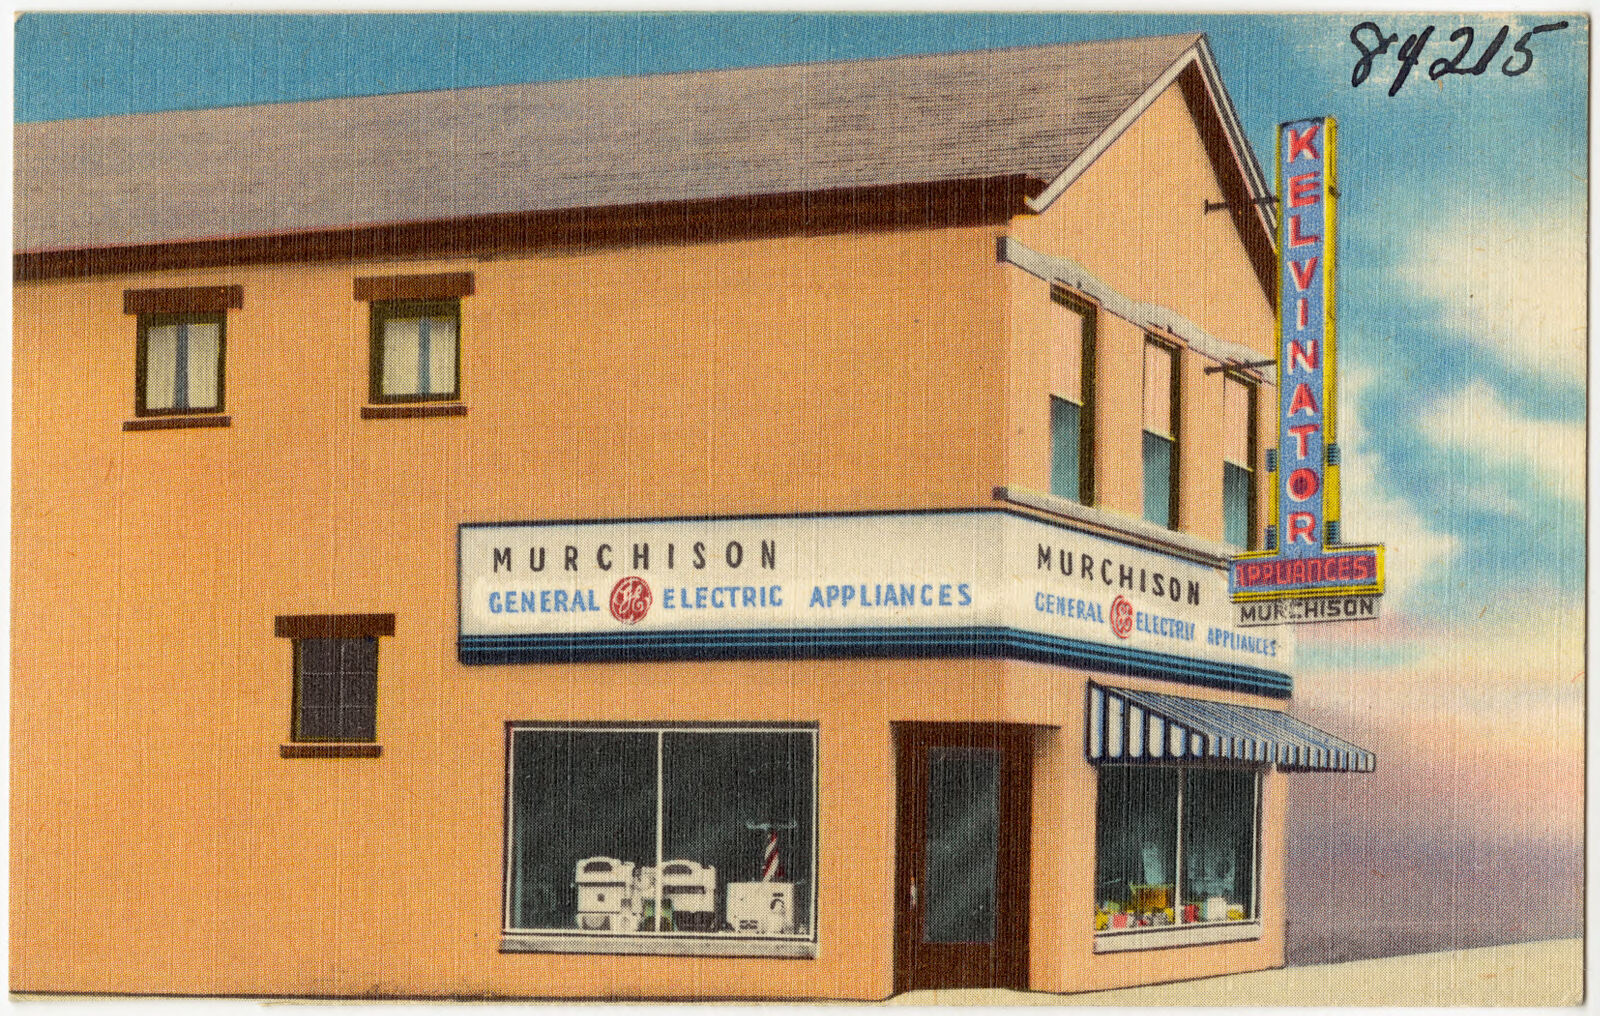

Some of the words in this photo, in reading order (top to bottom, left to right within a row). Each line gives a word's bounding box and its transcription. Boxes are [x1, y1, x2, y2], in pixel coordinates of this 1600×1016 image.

[1350, 21, 1569, 97] 84215
[1286, 124, 1321, 545] KELVINATOR
[493, 538, 778, 573] MURCHISON
[1037, 543, 1201, 606] MURCHISON
[488, 586, 601, 614] GENERAL
[663, 584, 784, 609] ELECTRIC
[808, 582, 973, 608] APPLIANCES
[1035, 591, 1105, 625] GENERAL
[1136, 611, 1196, 641] ELECTRIC
[1207, 627, 1278, 658] APPLIANCES
[1239, 597, 1374, 623] MURCHISON
